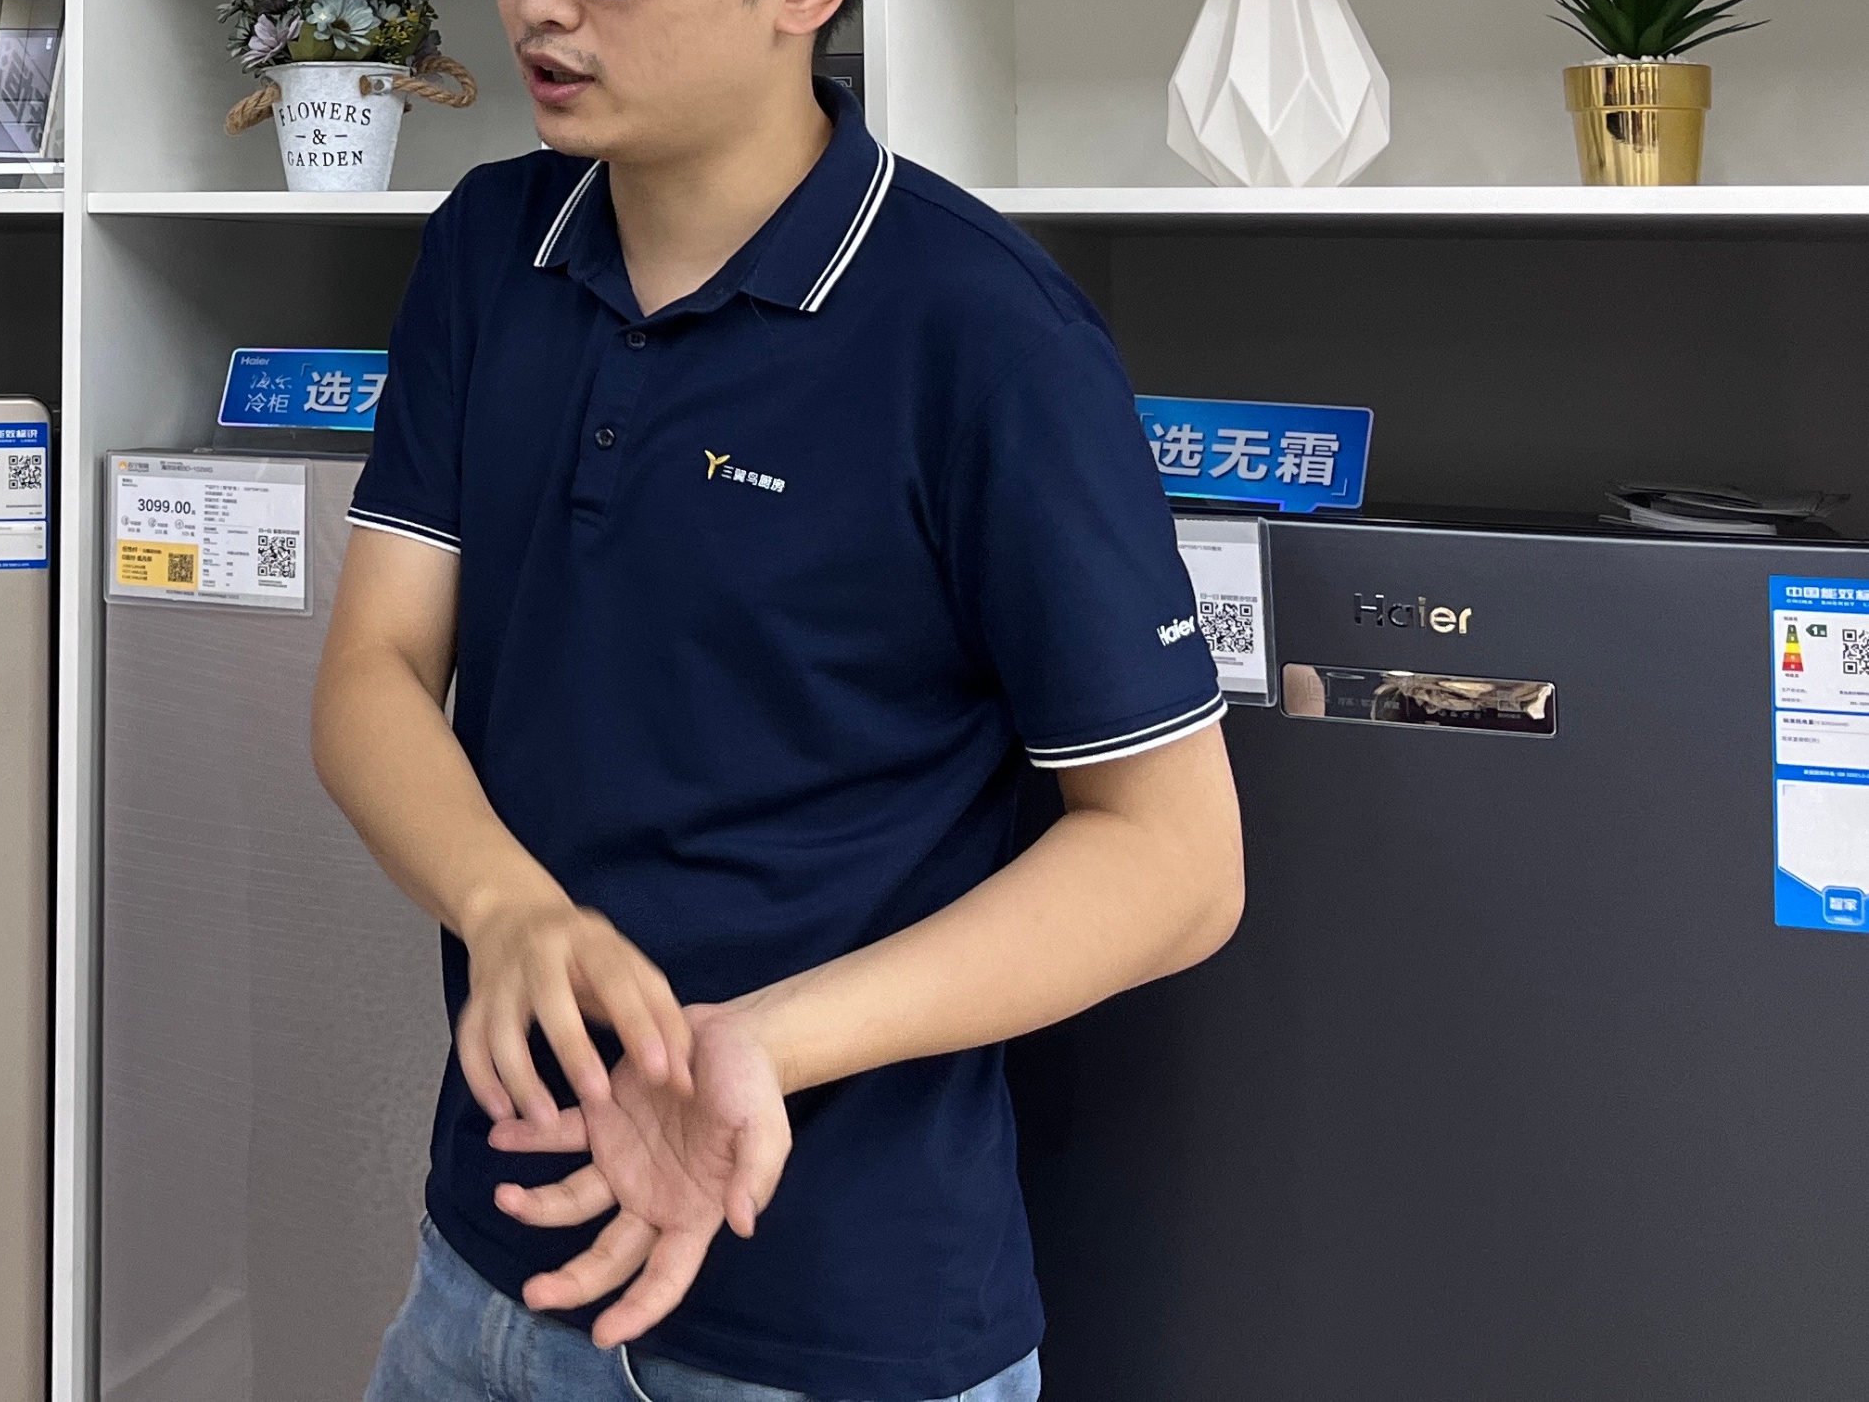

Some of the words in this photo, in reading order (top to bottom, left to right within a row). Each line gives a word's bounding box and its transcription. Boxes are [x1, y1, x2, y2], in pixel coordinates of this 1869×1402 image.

[277, 100, 373, 127] FLOWERS
[287, 149, 364, 167] GARDEN
[240, 355, 271, 367] Haier
[243, 393, 291, 414] 冷柜
[1149, 422, 1341, 486] 选无霜
[720, 464, 786, 493] 三翼鸟厨房
[1352, 593, 1473, 636] Haier
[1156, 615, 1196, 648] Haier
